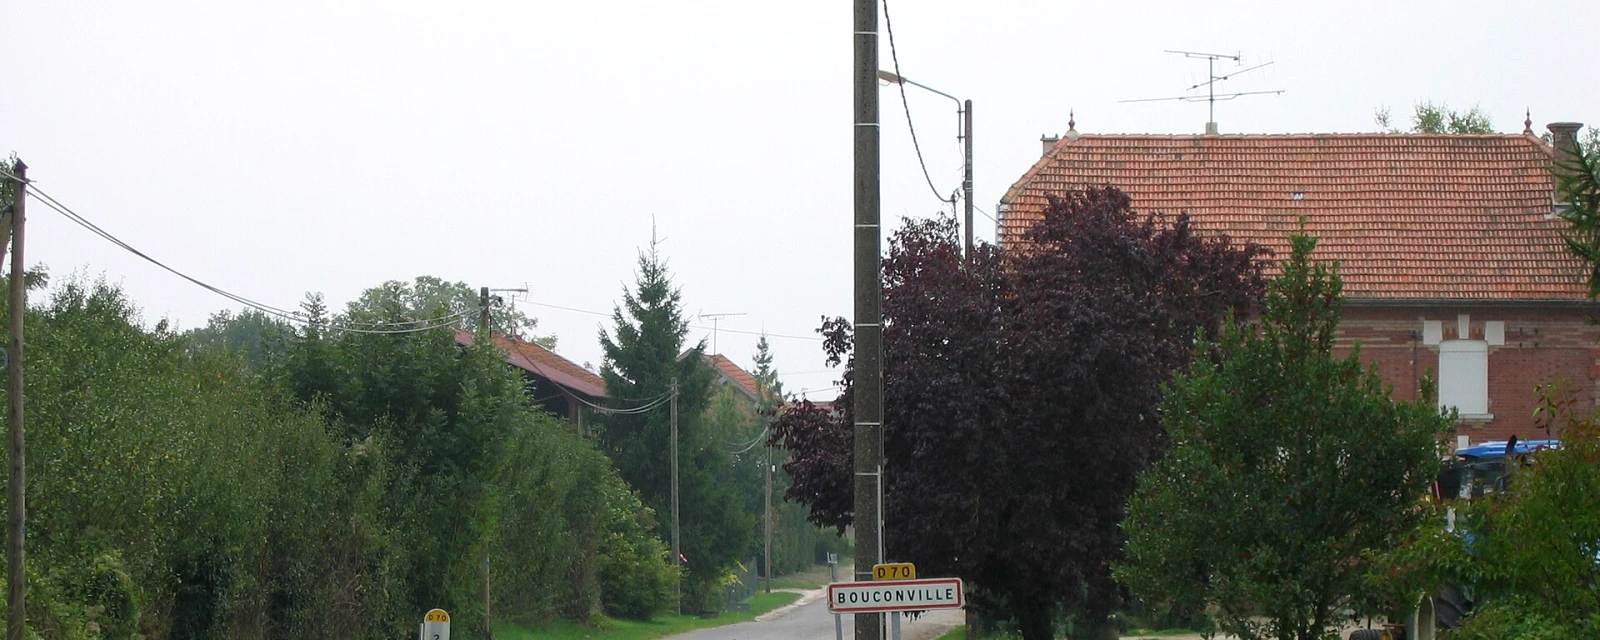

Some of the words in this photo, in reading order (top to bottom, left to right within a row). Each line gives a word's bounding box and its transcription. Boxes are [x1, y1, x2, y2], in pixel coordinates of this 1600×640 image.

[878, 567, 886, 579] D
[891, 566, 911, 578] 70
[837, 588, 954, 604] BOUCONVILLE
